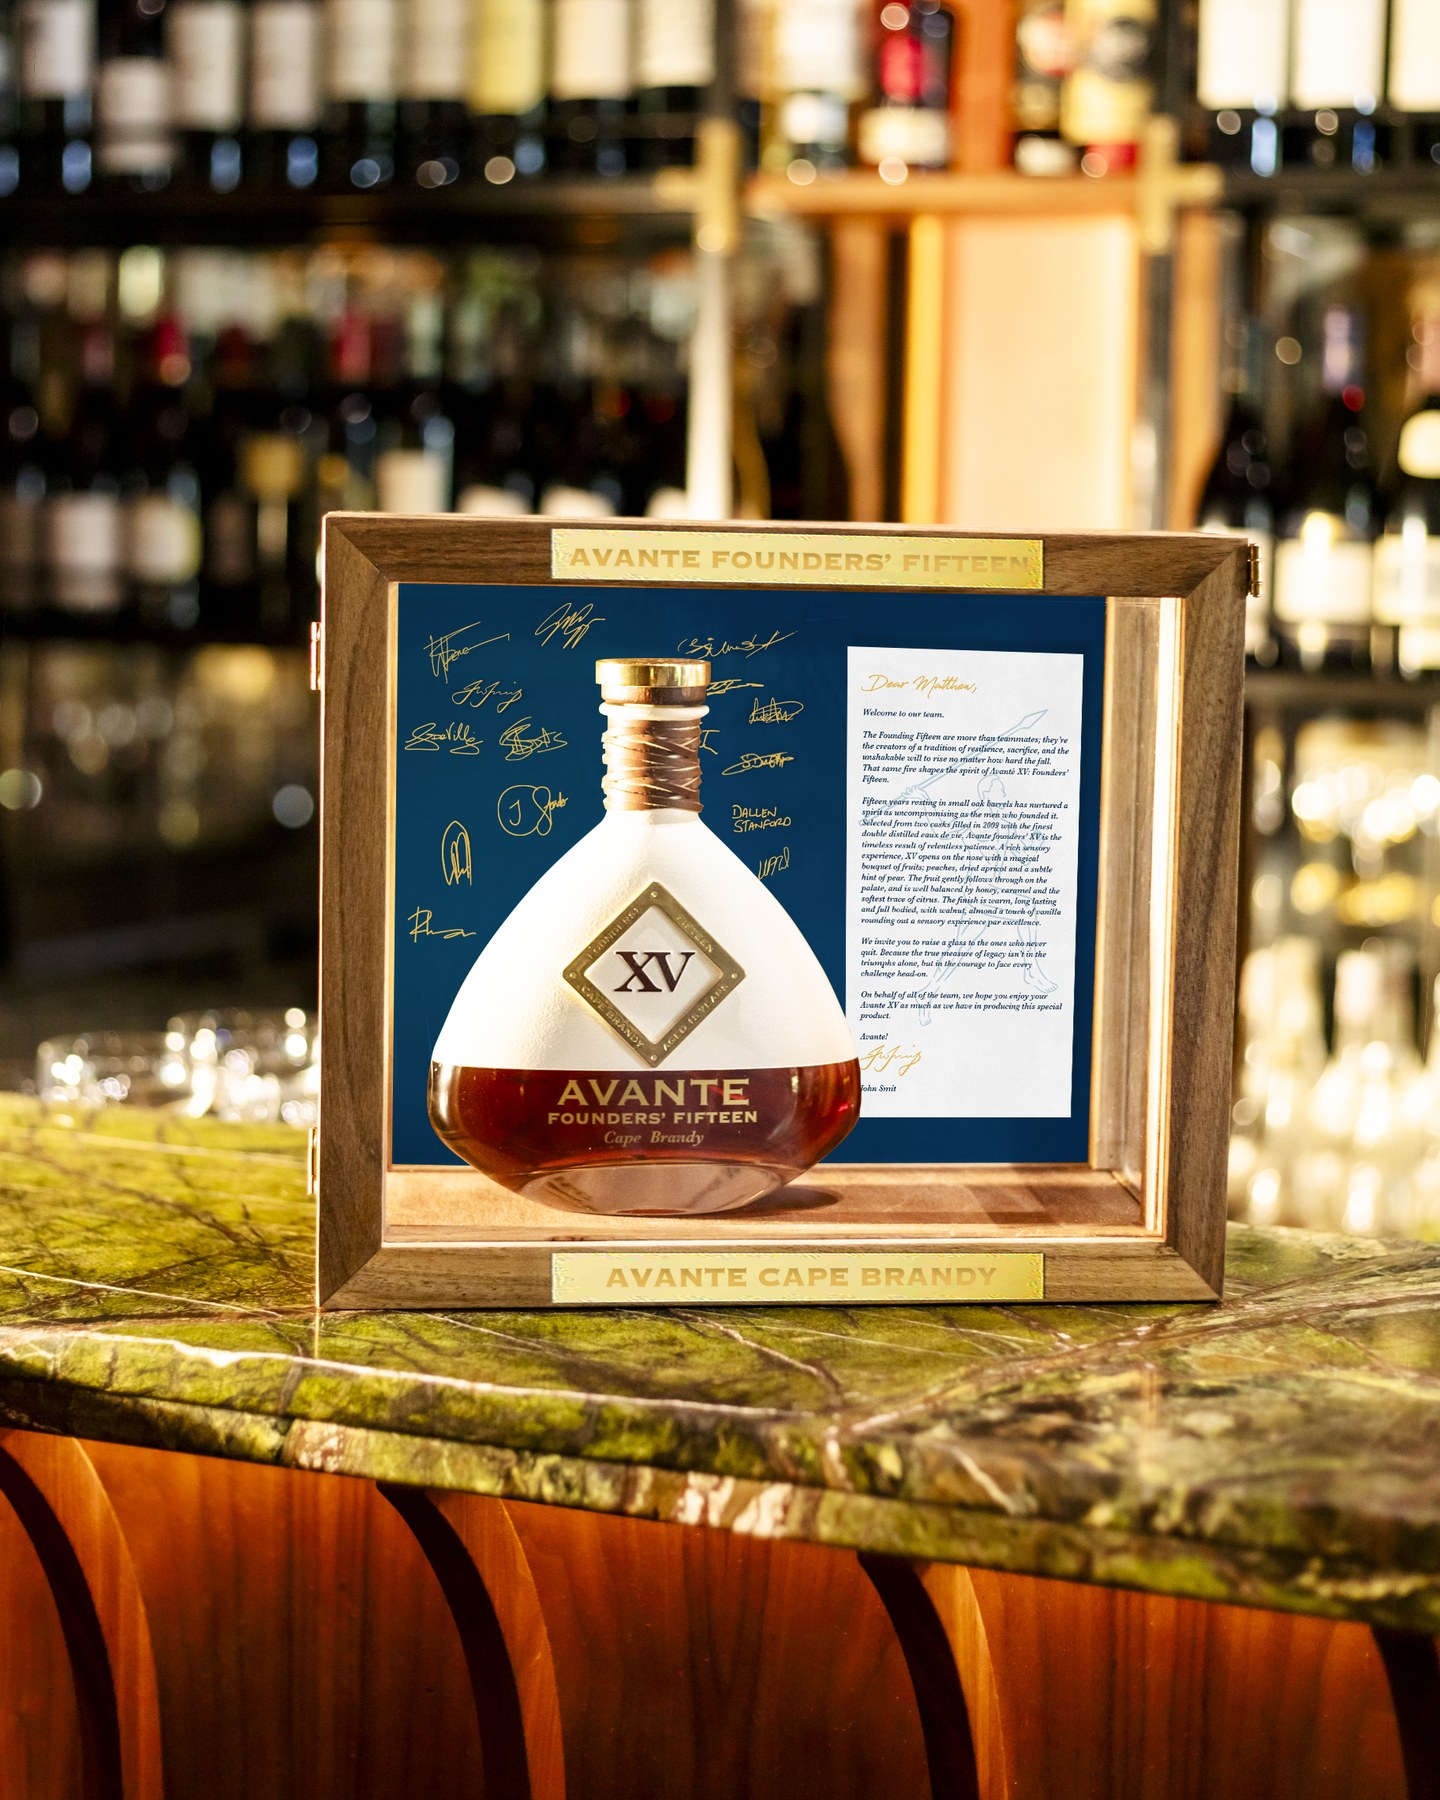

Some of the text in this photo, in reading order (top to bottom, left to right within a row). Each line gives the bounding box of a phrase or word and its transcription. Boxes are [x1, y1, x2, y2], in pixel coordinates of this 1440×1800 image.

[569, 548, 1029, 574] AVANTE FOUNDERS’ FIFTEEN
[860, 674, 978, 699] Dear Matthew,
[863, 708, 897, 716] Welcome
[862, 729, 877, 738] The
[878, 730, 914, 741] Founding
[915, 731, 941, 742] Fifteen
[978, 732, 995, 741] than
[997, 733, 1040, 743] teammates;
[862, 740, 874, 749] the
[875, 741, 906, 750] creators
[908, 742, 916, 752] of
[923, 742, 956, 751] tradition
[958, 743, 967, 753] of
[967, 743, 1004, 753] resilience,
[1006, 744, 1039, 755] sacrifice,
[1041, 745, 1056, 754] and
[1057, 746, 1069, 754] the
[862, 751, 905, 760] unshakable
[907, 752, 922, 761] will
[923, 753, 931, 761] to
[932, 753, 947, 762] rise
[959, 754, 986, 762] matter
[986, 754, 1003, 763] how
[1004, 755, 1023, 763] hard
[1024, 756, 1036, 764] the
[1035, 756, 1051, 766] fall.
[862, 762, 880, 771] That
[901, 763, 916, 774] fire
[918, 764, 944, 775] shapes
[945, 764, 957, 773] the
[958, 765, 979, 775] spirit
[980, 765, 990, 776] of
[862, 774, 889, 784] Fifteen.
[862, 796, 887, 806] Fifteen
[887, 799, 909, 807] years
[911, 797, 937, 807] resting
[947, 798, 970, 806] small
[970, 798, 985, 806] oak
[986, 799, 1012, 807] barrels
[1029, 800, 1062, 808] nurtured
[731, 804, 777, 819] DALLEN
[861, 807, 882, 817] spirit
[894, 808, 958, 819] uncompromising
[1001, 810, 1017, 818] who
[1017, 811, 1049, 821] founded
[1050, 811, 1058, 819] it.
[733, 816, 792, 833] STANFORD
[861, 850, 903, 861] experience,
[904, 851, 918, 859] XV
[952, 852, 964, 860] the
[1009, 853, 1039, 863] magical
[861, 861, 891, 871] bouquet
[892, 862, 901, 871] of
[900, 862, 924, 872] fruits;
[925, 862, 957, 872] peaches,
[959, 863, 979, 871] dried
[980, 863, 1006, 873] apricot
[1030, 864, 1052, 872] subtle
[860, 883, 886, 893] palate,
[887, 883, 902, 891] and
[929, 884, 963, 892] balanced
[964, 885, 973, 894] by
[975, 885, 999, 895] honey,
[1000, 885, 1031, 893] caramel
[861, 894, 885, 904] softest
[886, 894, 905, 902] trace
[906, 894, 916, 904] of
[915, 894, 939, 902] citrus.
[955, 895, 978, 905] finish
[980, 895, 986, 903] is
[1014, 896, 1030, 906] long
[1031, 896, 1056, 906] lasting
[861, 915, 895, 925] rounding
[946, 916, 986, 926] experience
[1002, 917, 1041, 925] excellence.
[676, 913, 715, 953] FIFTEEN
[614, 951, 696, 992] XV
[860, 968, 895, 978] challenge
[859, 1000, 885, 1008] Avante
[886, 1000, 899, 1008] XV
[982, 1001, 1020, 1011] producing
[1036, 1002, 1062, 1011] special
[581, 984, 645, 1049] CAPE BRANDY
[859, 1011, 891, 1021] product.
[663, 1024, 688, 1051] AGED
[687, 1012, 701, 1026] 15
[556, 1078, 750, 1107] AVANTE
[548, 1110, 758, 1125] FOUNDERS’ FIFTEEN
[603, 1130, 705, 1147] Cape Brandy
[605, 1266, 998, 1288] AVANTE CAPE BRANDY
